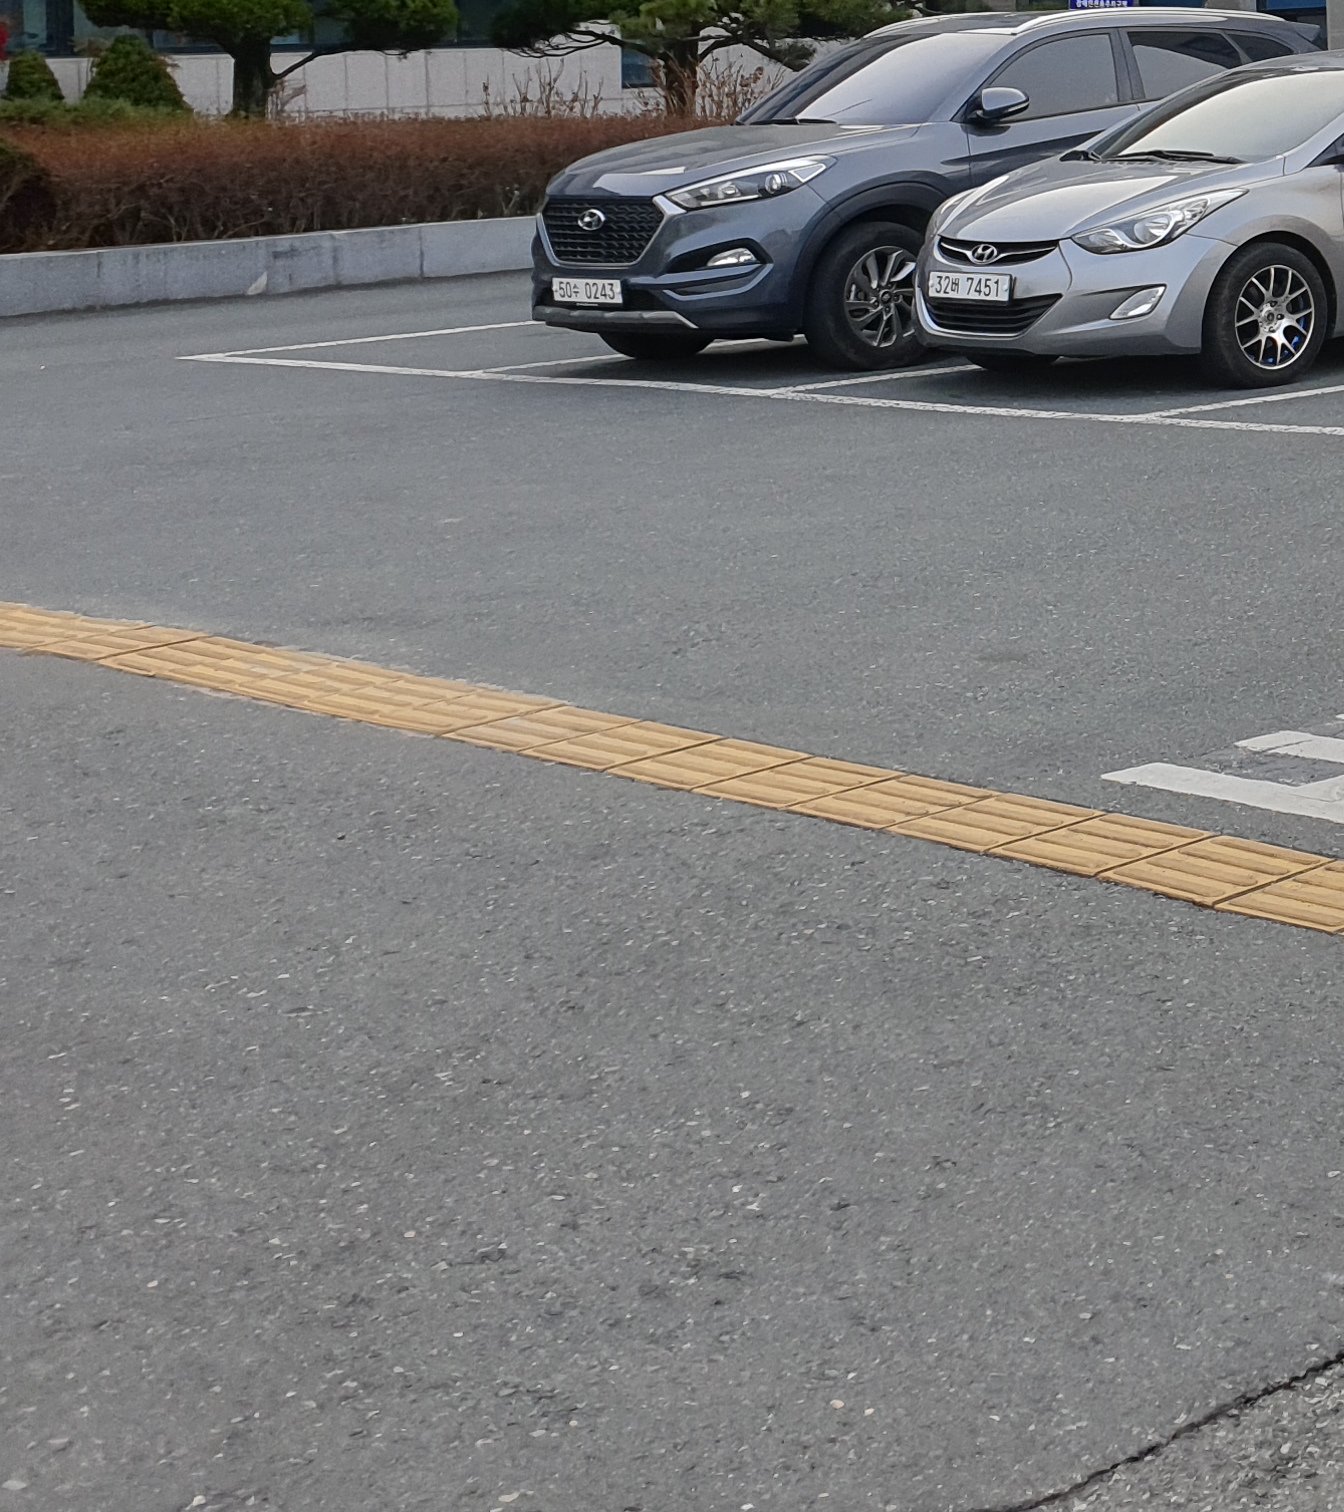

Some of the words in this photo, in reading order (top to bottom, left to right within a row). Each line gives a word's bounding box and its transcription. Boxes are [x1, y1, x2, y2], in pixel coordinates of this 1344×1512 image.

[558, 281, 580, 299] 50수
[584, 282, 616, 300] 0243
[935, 275, 960, 294] 32버
[966, 277, 1000, 298] 7451
